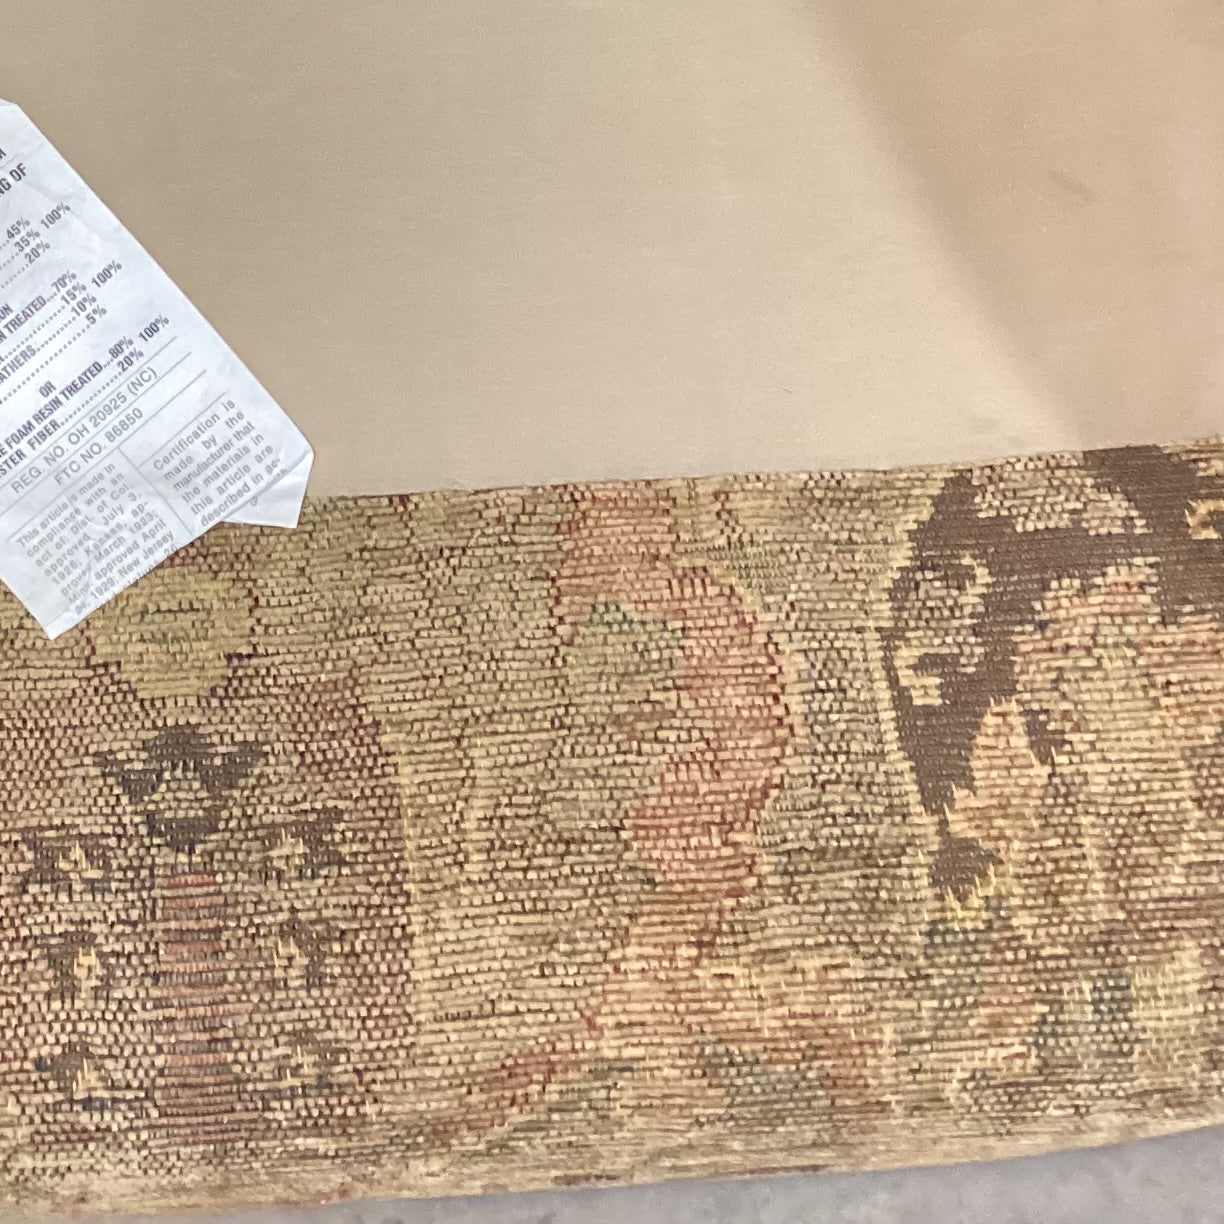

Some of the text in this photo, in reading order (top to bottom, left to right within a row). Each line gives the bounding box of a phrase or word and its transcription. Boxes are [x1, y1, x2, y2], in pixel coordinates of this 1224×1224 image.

[8, 161, 29, 182] OF
[39, 200, 71, 229] 100%
[89, 257, 123, 289] 100%
[137, 312, 170, 343] 100%
[3, 419, 36, 449] FOAM
[31, 395, 64, 425] RESIN
[37, 379, 56, 399] OR
[10, 365, 159, 494] REG. NO. OH 20925 (NC)
[53, 406, 145, 485] FTC NO. 86850
[151, 397, 236, 471] Certification is
[162, 409, 246, 482] made by the
[172, 420, 255, 492] manufacturer that
[181, 484, 202, 503] the
[200, 443, 251, 487] materials
[250, 431, 264, 445] in
[189, 493, 214, 516] this
[214, 461, 252, 495] article
[253, 444, 274, 463] are
[198, 481, 251, 527] described
[249, 471, 264, 485] in
[15, 461, 116, 548] This article is made in
[24, 471, 124, 559] compliance with an
[33, 549, 53, 567] act
[95, 500, 109, 513] of
[41, 532, 93, 577] approved
[99, 502, 126, 527] July
[92, 539, 141, 582] approved
[139, 518, 167, 543] April
[93, 534, 126, 563] March
[117, 555, 141, 577] New
[140, 528, 176, 561] Jersey
